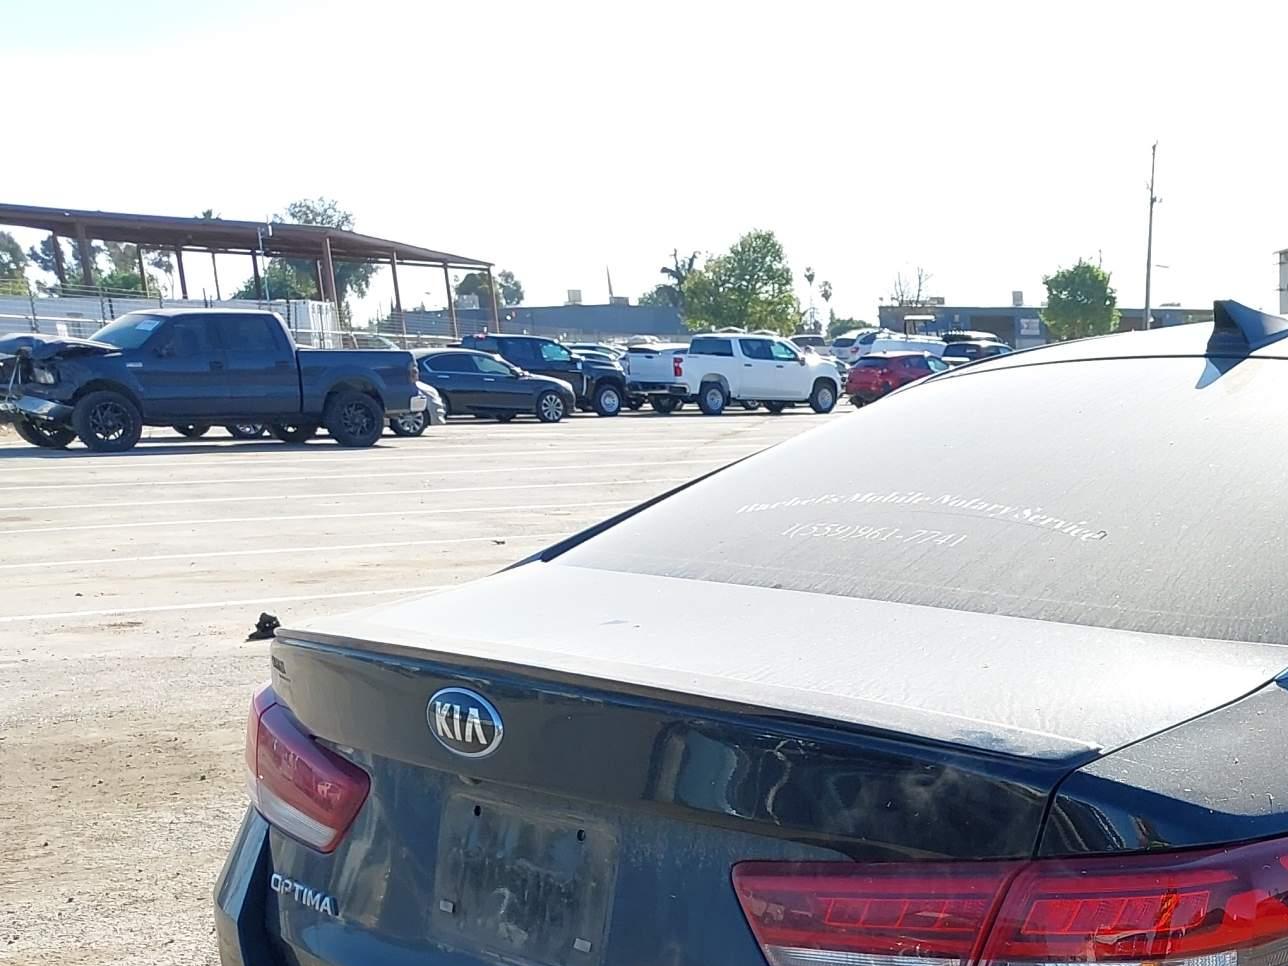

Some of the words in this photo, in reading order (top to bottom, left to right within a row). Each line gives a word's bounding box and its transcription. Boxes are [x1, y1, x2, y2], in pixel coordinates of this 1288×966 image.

[843, 491, 931, 504] Mobile
[930, 494, 1018, 518] Notary
[434, 701, 488, 745] KIA
[270, 873, 332, 917] OPTIMA
